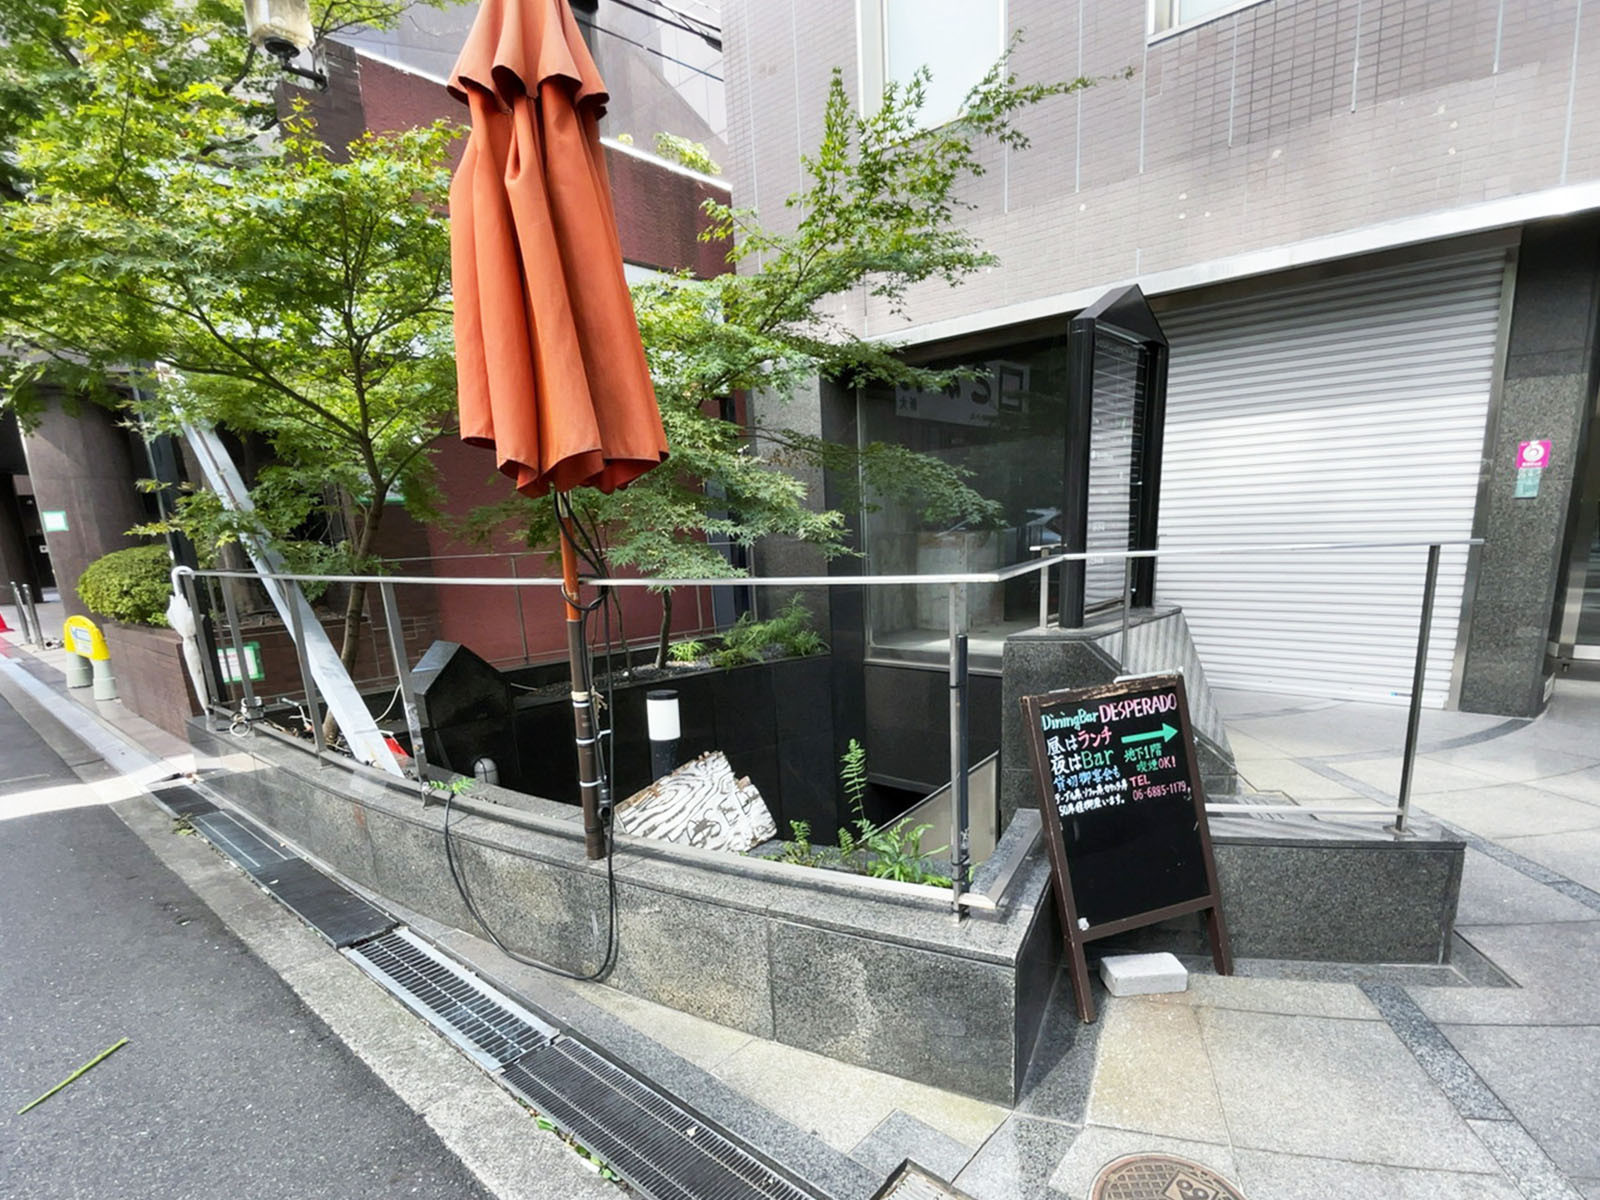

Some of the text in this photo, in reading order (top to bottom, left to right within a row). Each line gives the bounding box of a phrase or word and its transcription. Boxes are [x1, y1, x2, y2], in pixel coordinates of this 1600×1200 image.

[1099, 693, 1177, 723] DESPERADO
[1046, 725, 1113, 756] 昼はランチ
[1124, 742, 1162, 763] 地下1階
[1050, 749, 1114, 775] 夜はBar
[1129, 774, 1151, 787] TEL
